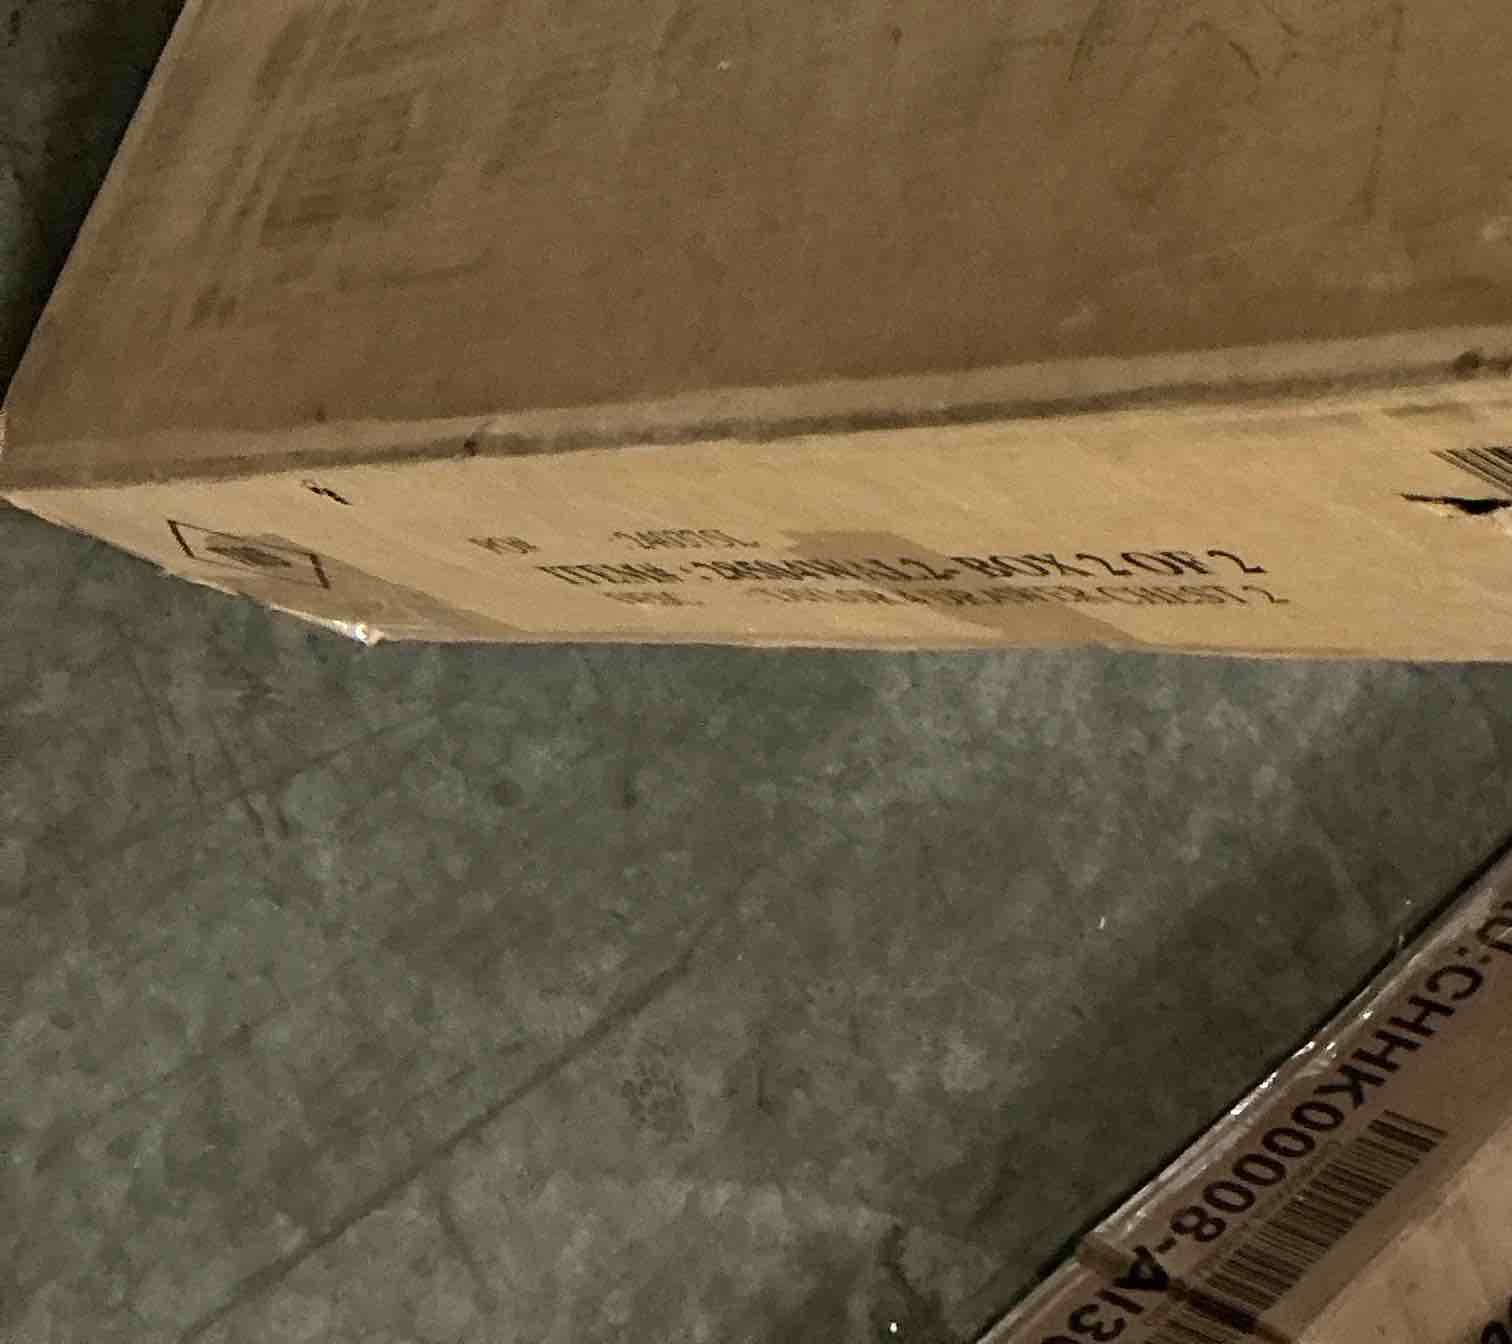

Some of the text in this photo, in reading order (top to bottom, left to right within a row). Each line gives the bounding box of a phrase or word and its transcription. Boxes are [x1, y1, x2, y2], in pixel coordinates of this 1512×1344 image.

[950, 553, 1095, 577] BOX
[1075, 552, 1133, 576] 2
[1121, 550, 1210, 575] OF
[1206, 549, 1267, 573] 2
[1241, 584, 1289, 603] 2
